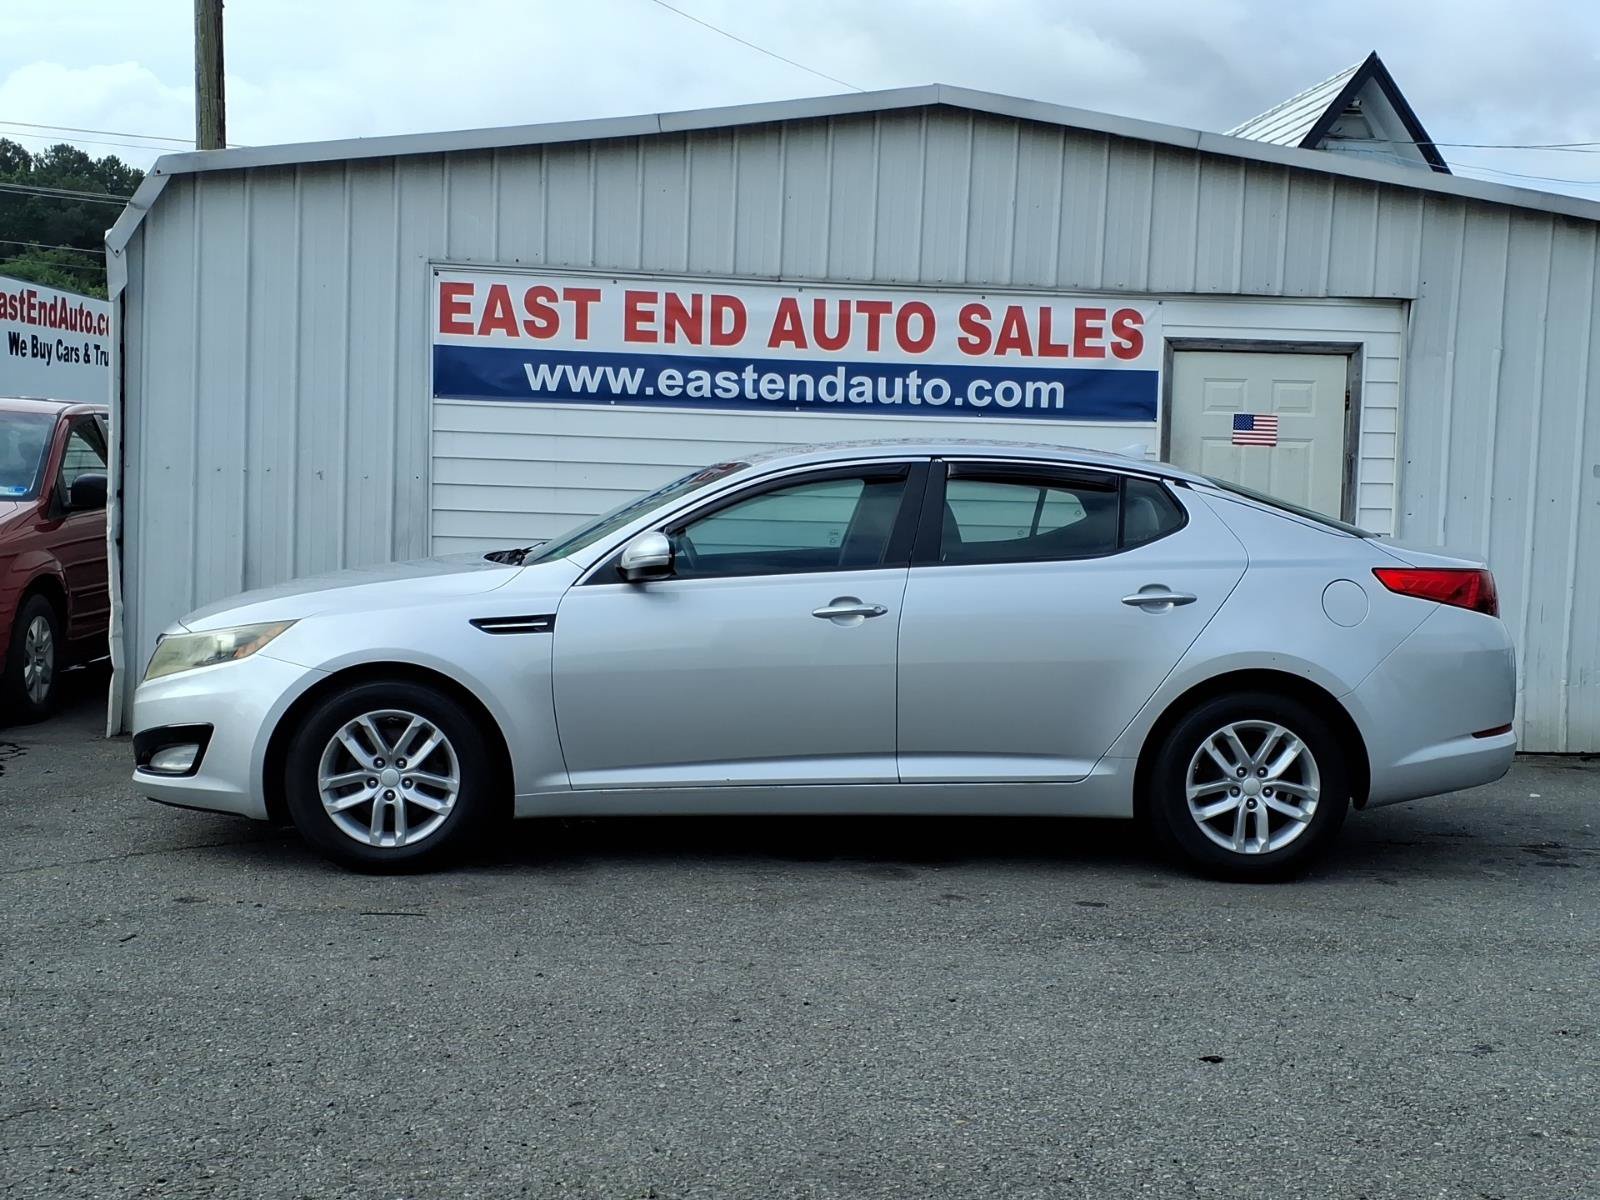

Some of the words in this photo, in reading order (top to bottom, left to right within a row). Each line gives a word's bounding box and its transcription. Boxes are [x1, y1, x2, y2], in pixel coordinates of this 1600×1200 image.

[0, 288, 109, 336] astEndAuto.c
[439, 281, 601, 340] EAST
[623, 290, 748, 346] END
[767, 297, 937, 354] AUTO
[957, 303, 1145, 360] SALES
[8, 331, 27, 358] We
[31, 335, 52, 366] Buy
[56, 339, 80, 364] Cars
[83, 342, 91, 364] &
[524, 363, 1065, 409] www.eastendauto.com
